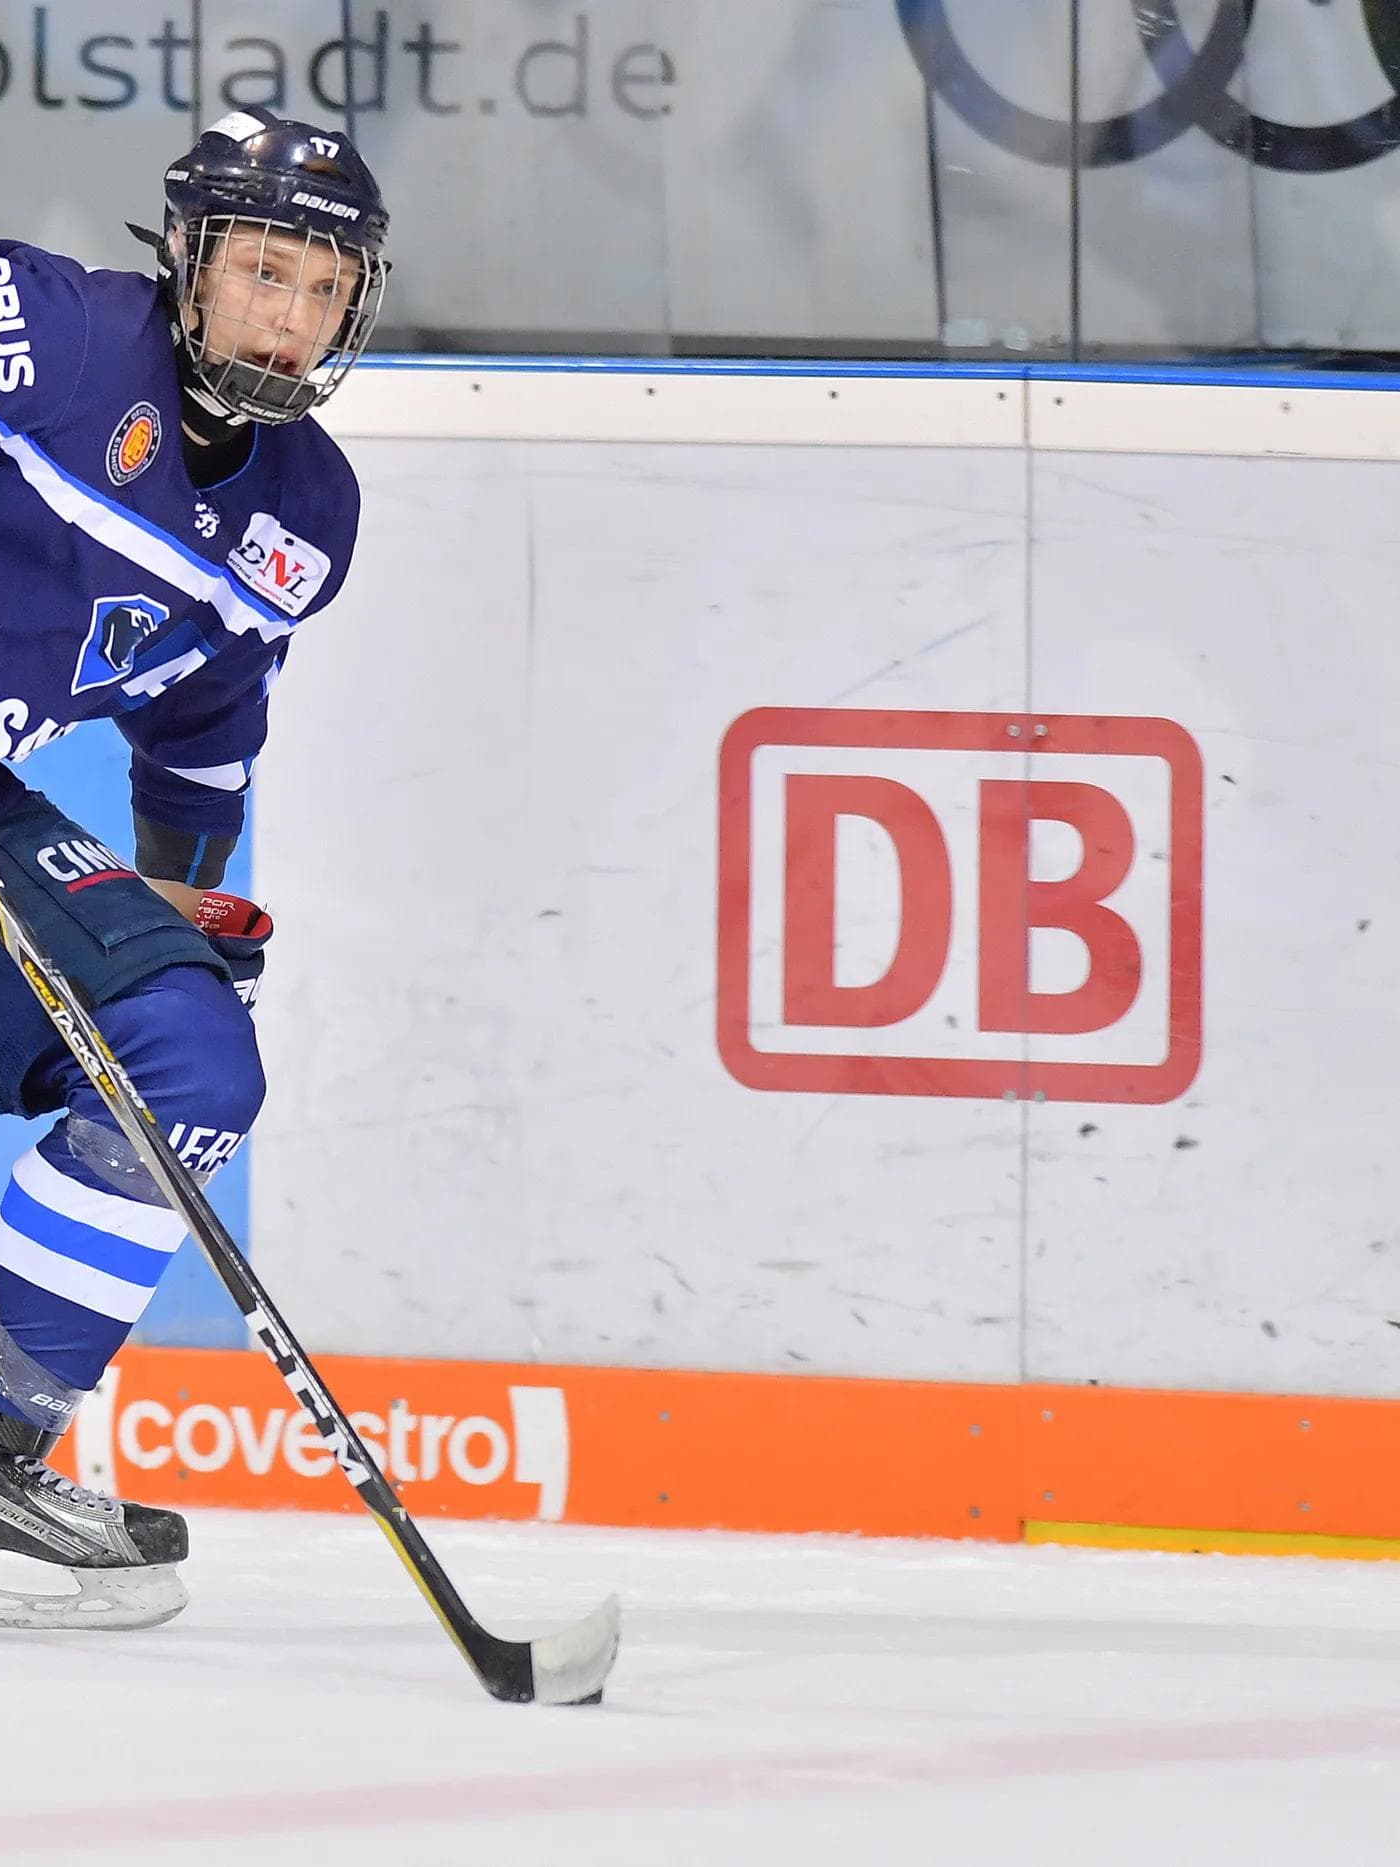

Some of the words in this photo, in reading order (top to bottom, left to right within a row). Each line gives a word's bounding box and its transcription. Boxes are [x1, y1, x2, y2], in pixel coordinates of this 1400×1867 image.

[309, 136, 341, 159] 17
[291, 191, 360, 222] BAUER
[36, 839, 133, 883] CIN
[783, 773, 1144, 1035] DB
[244, 1301, 372, 1488] CCM
